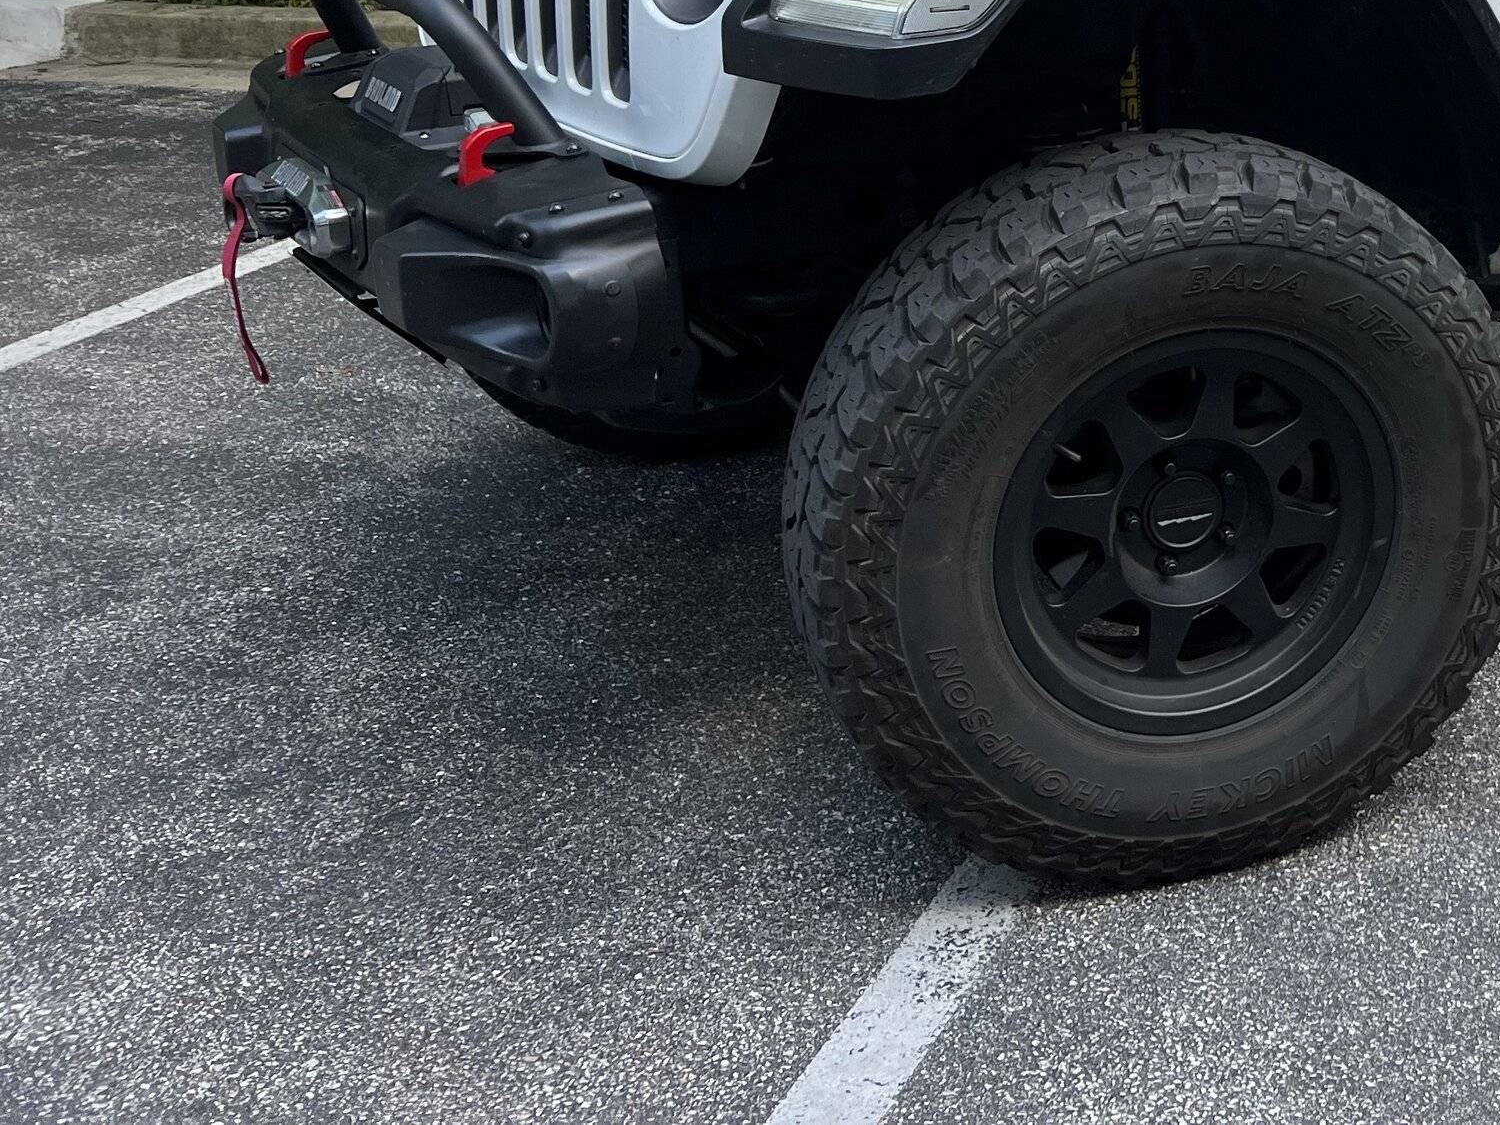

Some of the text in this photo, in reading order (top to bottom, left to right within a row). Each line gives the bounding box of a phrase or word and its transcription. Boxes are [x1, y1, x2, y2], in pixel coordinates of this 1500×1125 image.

[1183, 263, 1309, 299] BAJA
[925, 645, 1335, 823] MICKEY THOMPSON
